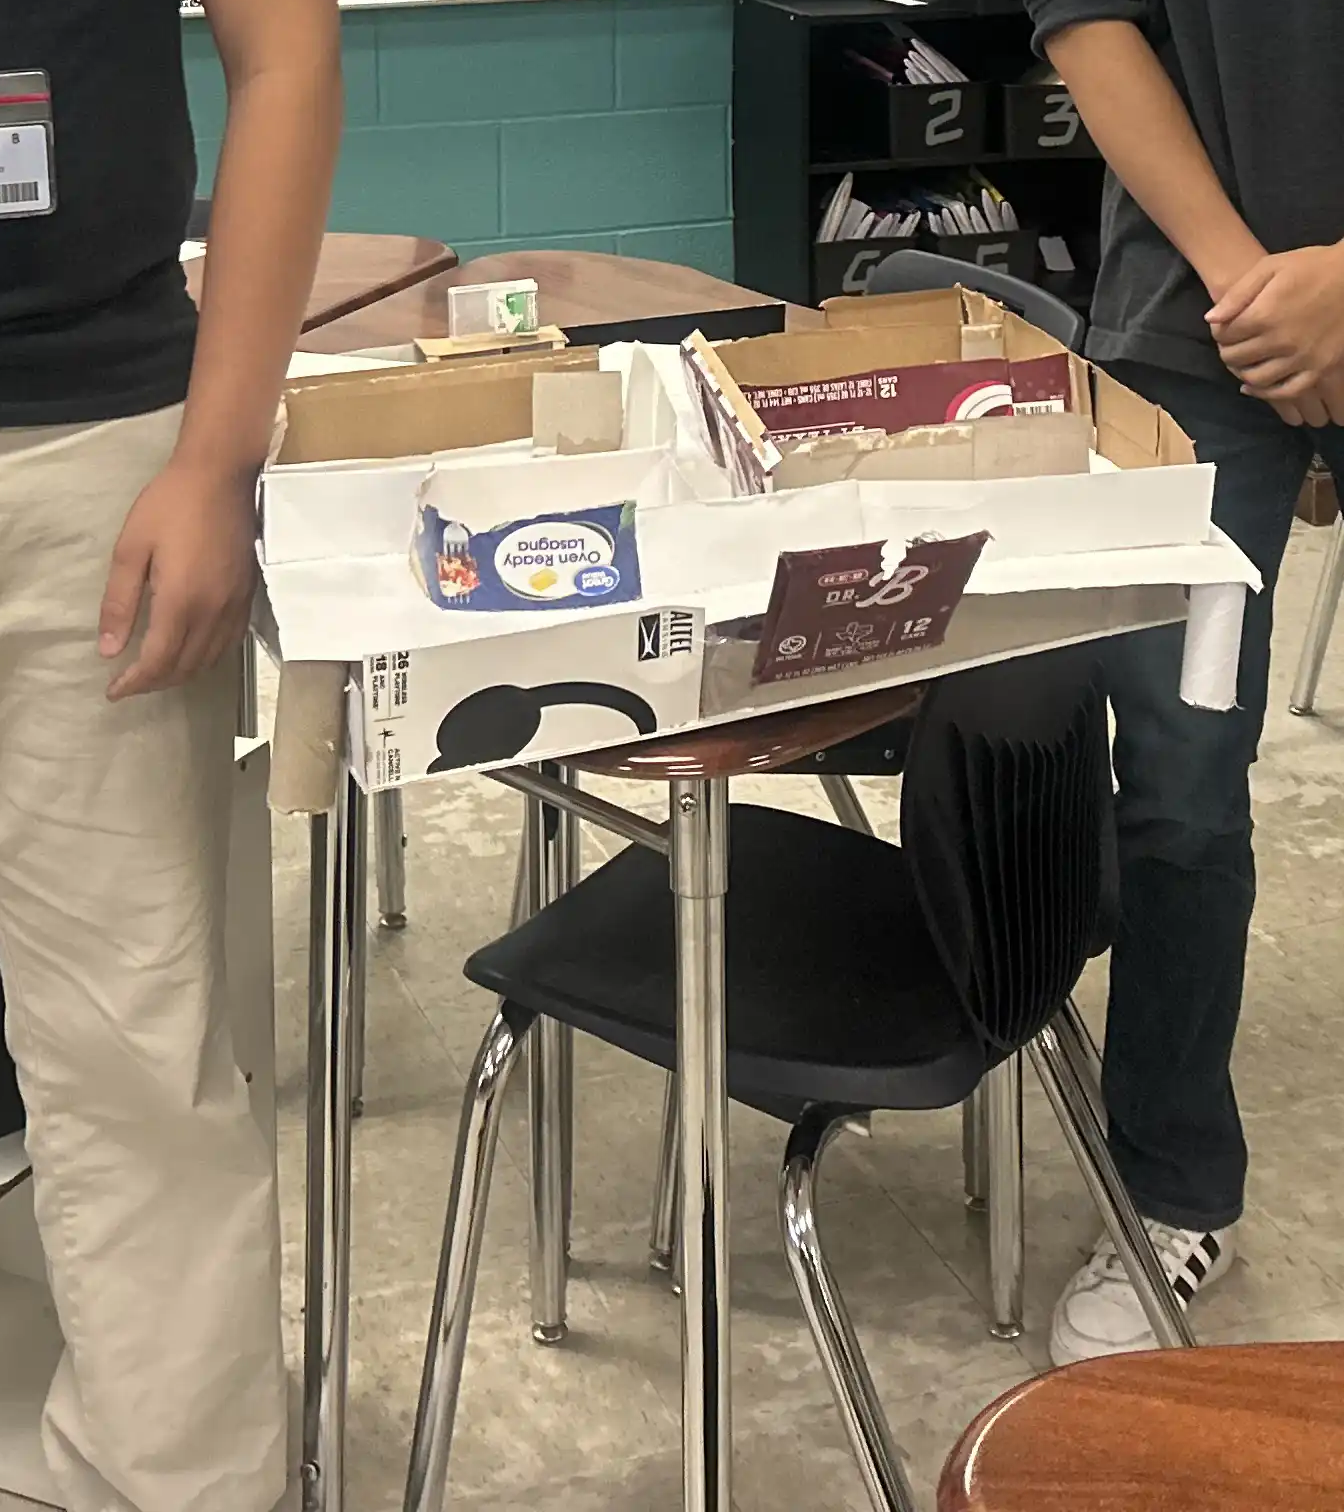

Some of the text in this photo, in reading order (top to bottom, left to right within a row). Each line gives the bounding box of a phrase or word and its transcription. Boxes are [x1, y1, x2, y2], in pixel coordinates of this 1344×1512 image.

[925, 90, 1081, 147] 2 3
[881, 383, 897, 399] 12
[518, 537, 585, 551] Lasagna
[504, 549, 601, 568] Oven Ready
[826, 588, 859, 604] DR.
[670, 610, 693, 656] ALTEC
[903, 617, 932, 634] 12
[375, 654, 387, 671] 18
[398, 651, 409, 670] 26
